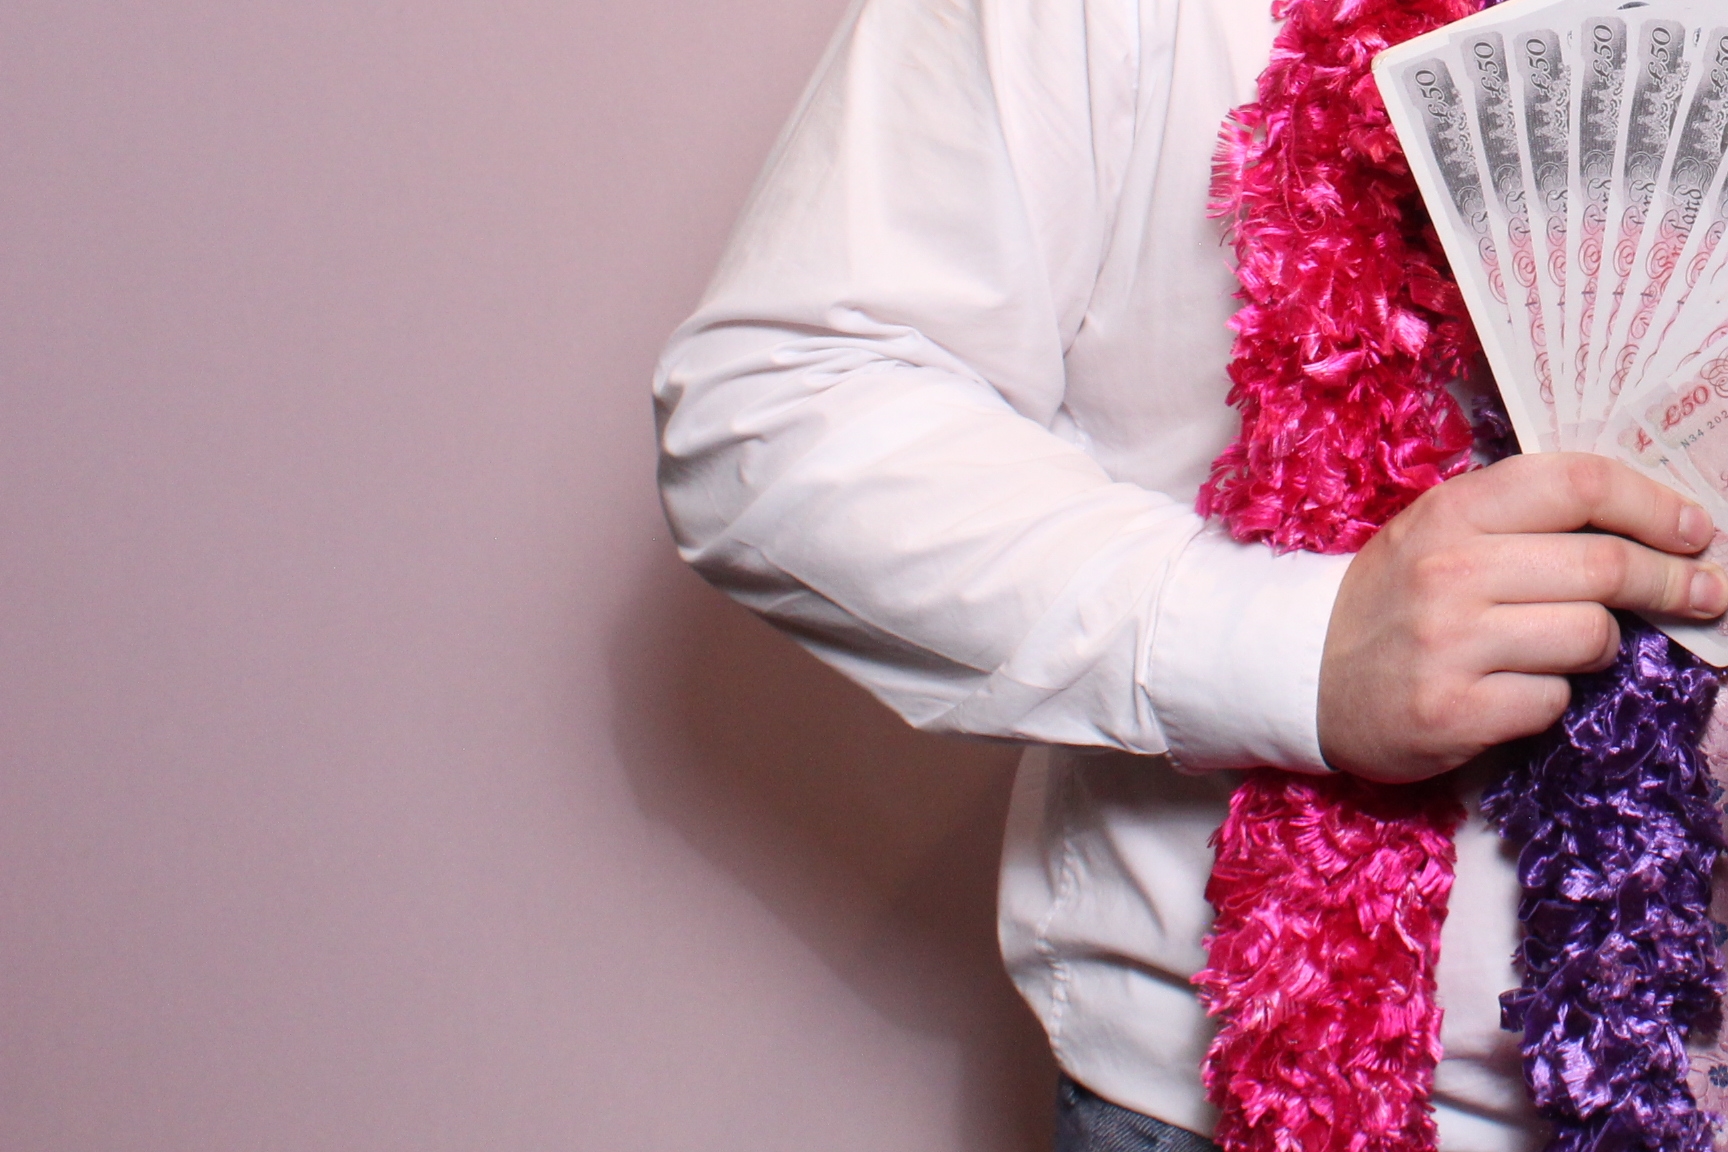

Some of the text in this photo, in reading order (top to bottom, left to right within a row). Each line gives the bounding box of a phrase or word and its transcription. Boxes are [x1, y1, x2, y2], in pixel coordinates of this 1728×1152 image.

[1473, 41, 1503, 98] £50
[1526, 38, 1551, 96] £50
[1593, 24, 1614, 84] £50
[1648, 26, 1672, 86] £50
[1415, 69, 1451, 124] £50
[1662, 386, 1710, 431] £50
[1680, 428, 1705, 449] N34
